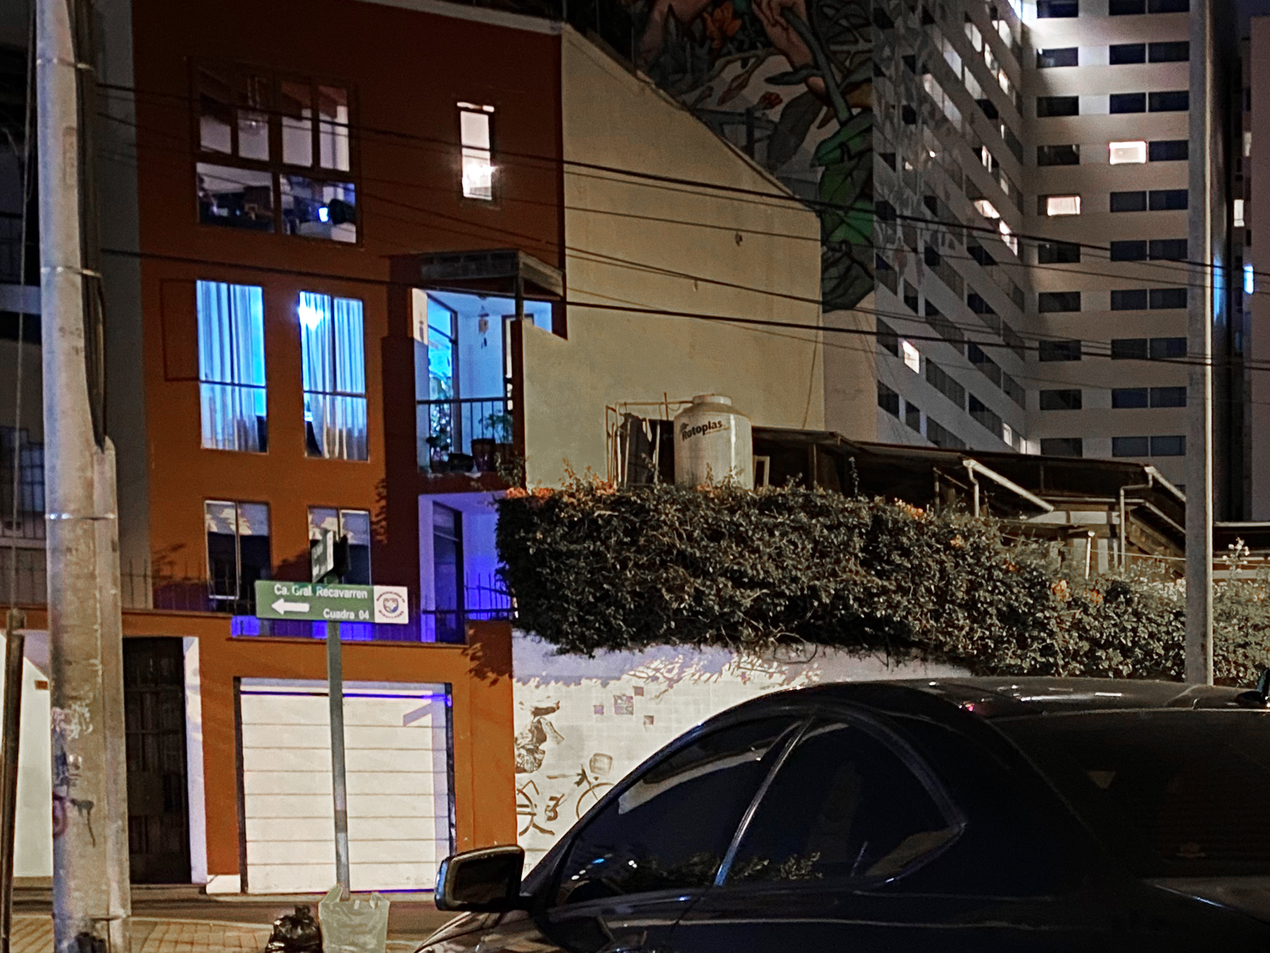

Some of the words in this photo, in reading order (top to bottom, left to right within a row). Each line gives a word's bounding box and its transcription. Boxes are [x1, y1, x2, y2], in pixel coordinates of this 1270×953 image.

[682, 421, 723, 441] Rotoplas
[274, 584, 289, 595] Ca.
[316, 587, 368, 599] Recavarren
[323, 608, 355, 620] Cuadra
[359, 610, 370, 620] 04
